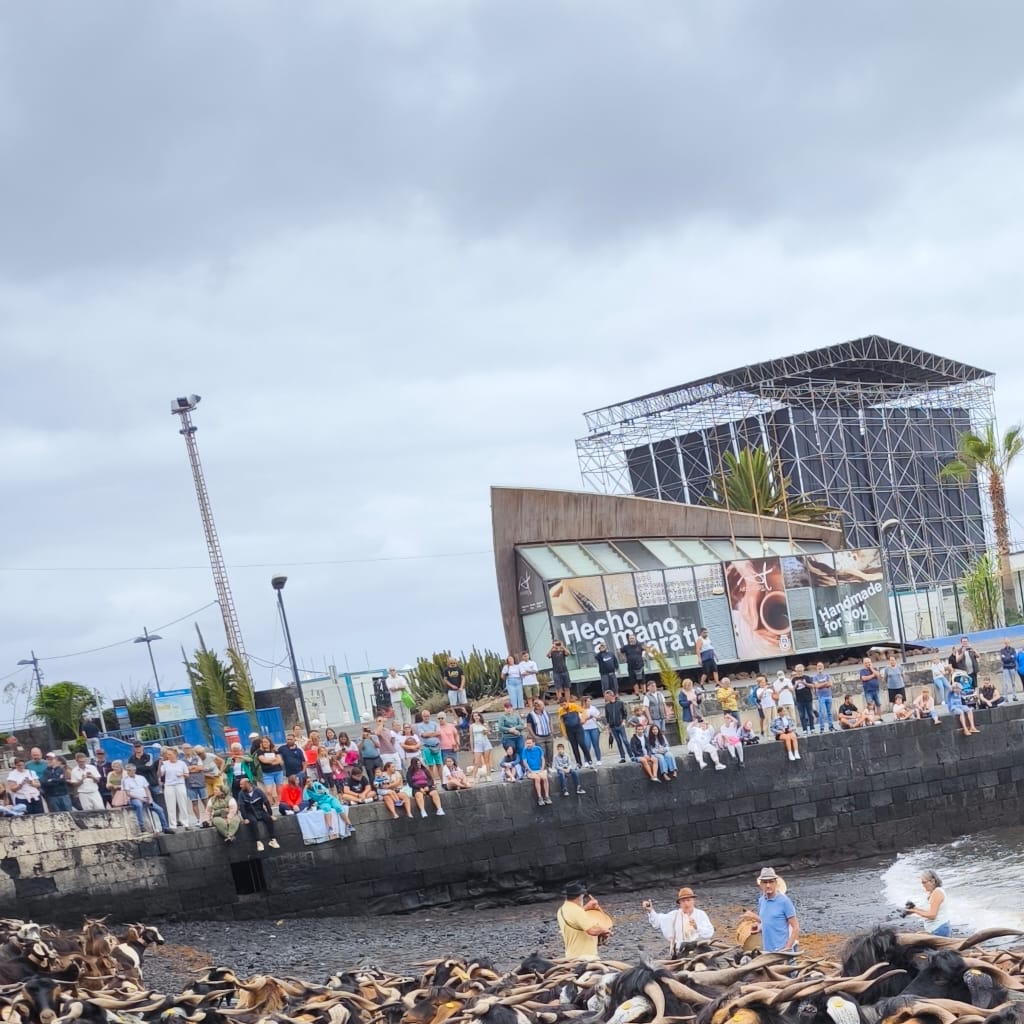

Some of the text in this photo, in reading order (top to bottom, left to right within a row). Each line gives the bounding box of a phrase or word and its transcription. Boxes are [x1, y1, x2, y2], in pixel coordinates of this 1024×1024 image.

[818, 582, 883, 621] Handmade
[560, 610, 638, 645] Hecho
[613, 617, 678, 649] mano
[683, 624, 699, 647] ti
[824, 617, 842, 634] for
